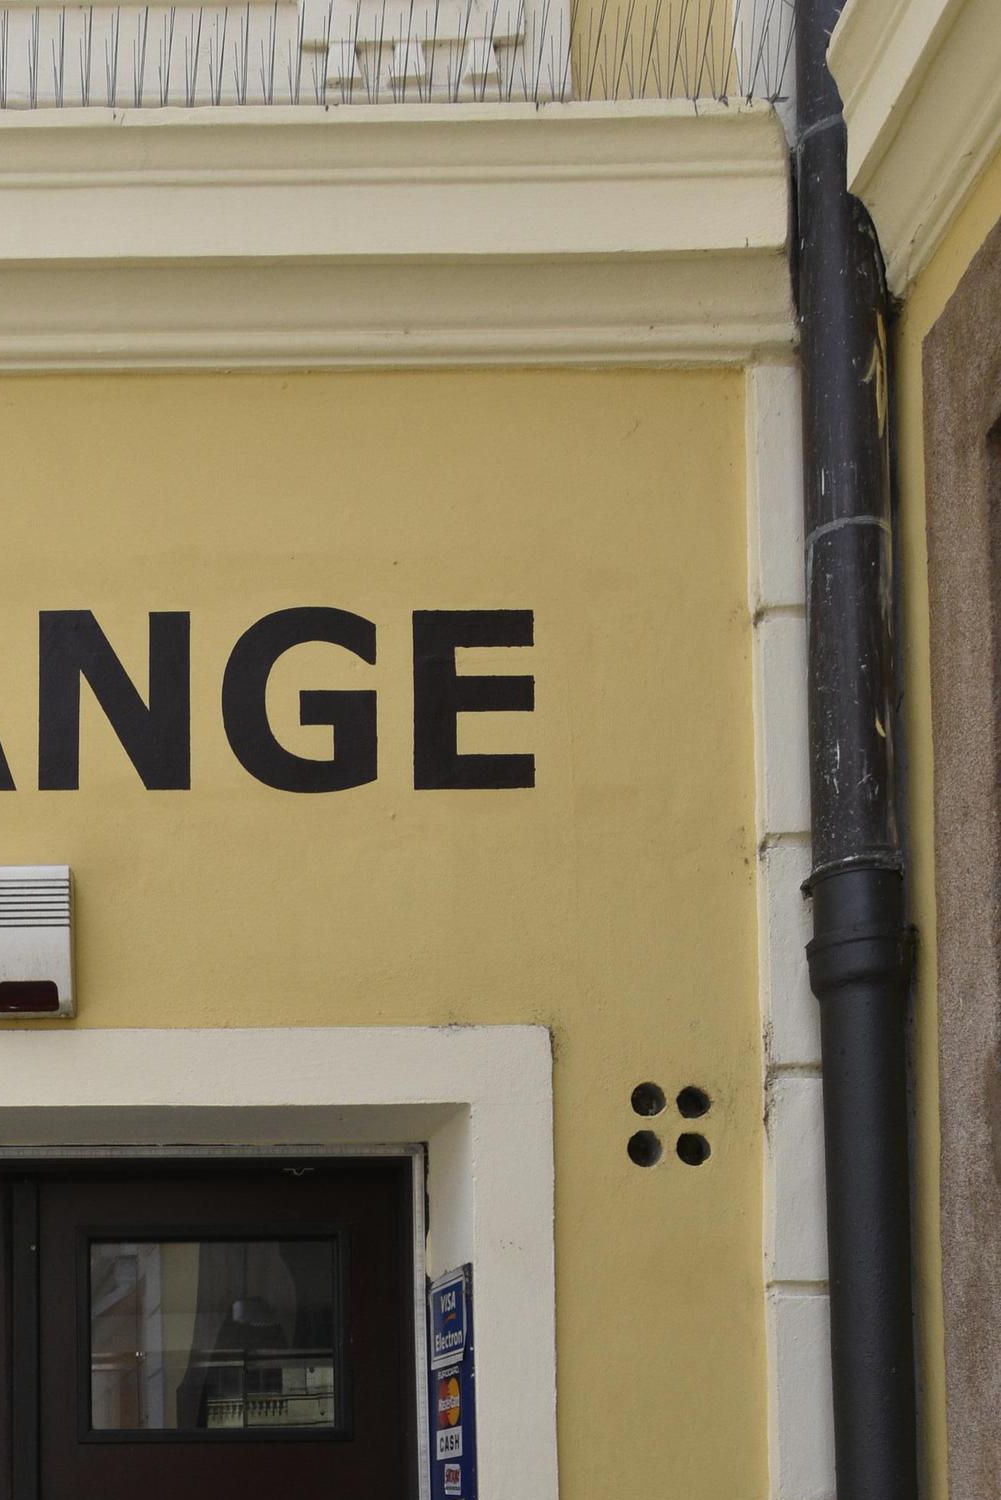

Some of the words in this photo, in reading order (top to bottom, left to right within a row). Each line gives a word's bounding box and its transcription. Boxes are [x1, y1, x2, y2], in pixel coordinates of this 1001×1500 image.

[440, 1291, 456, 1313] VISA
[435, 1331, 462, 1351] Electron
[440, 1434, 460, 1453] CASH
